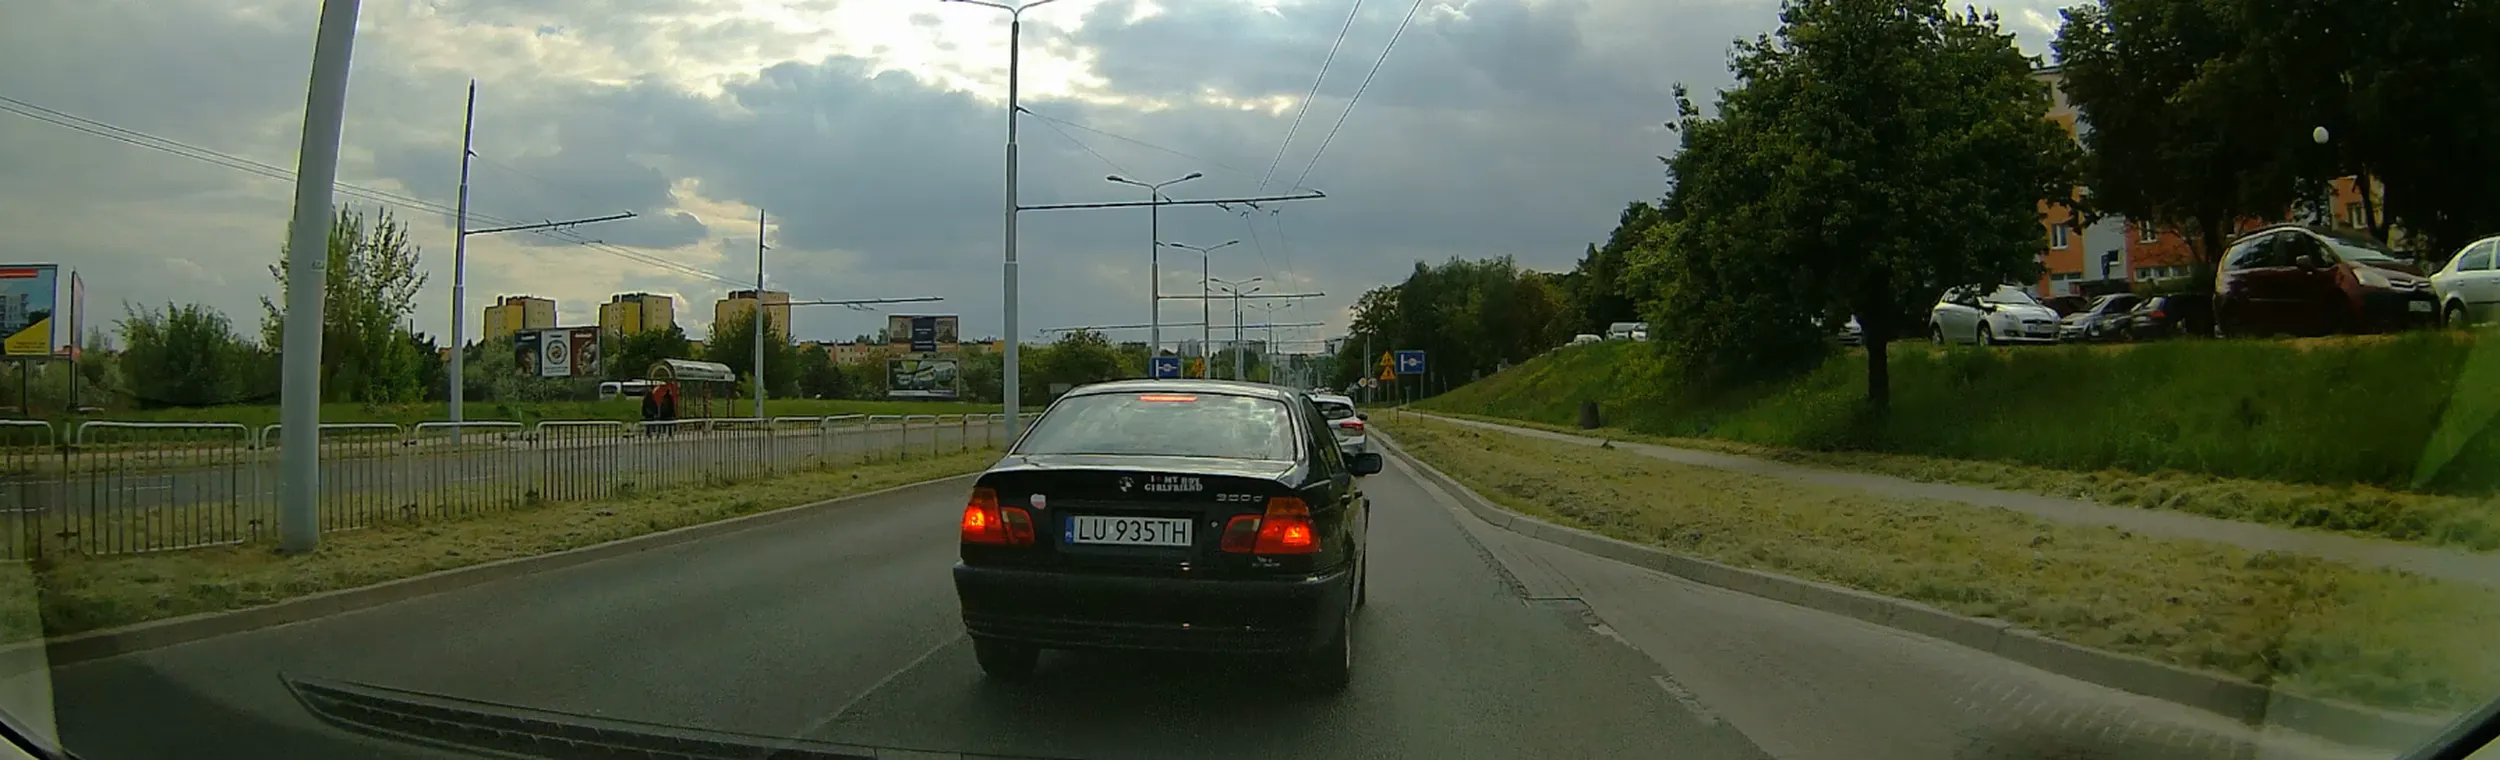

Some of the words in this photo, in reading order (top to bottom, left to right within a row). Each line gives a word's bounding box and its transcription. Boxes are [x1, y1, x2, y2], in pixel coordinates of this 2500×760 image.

[1164, 476, 1179, 484] MY
[1144, 484, 1203, 492] GIRLFRIEND
[1078, 518, 1106, 540] LU
[1116, 519, 1187, 544] 935TH
